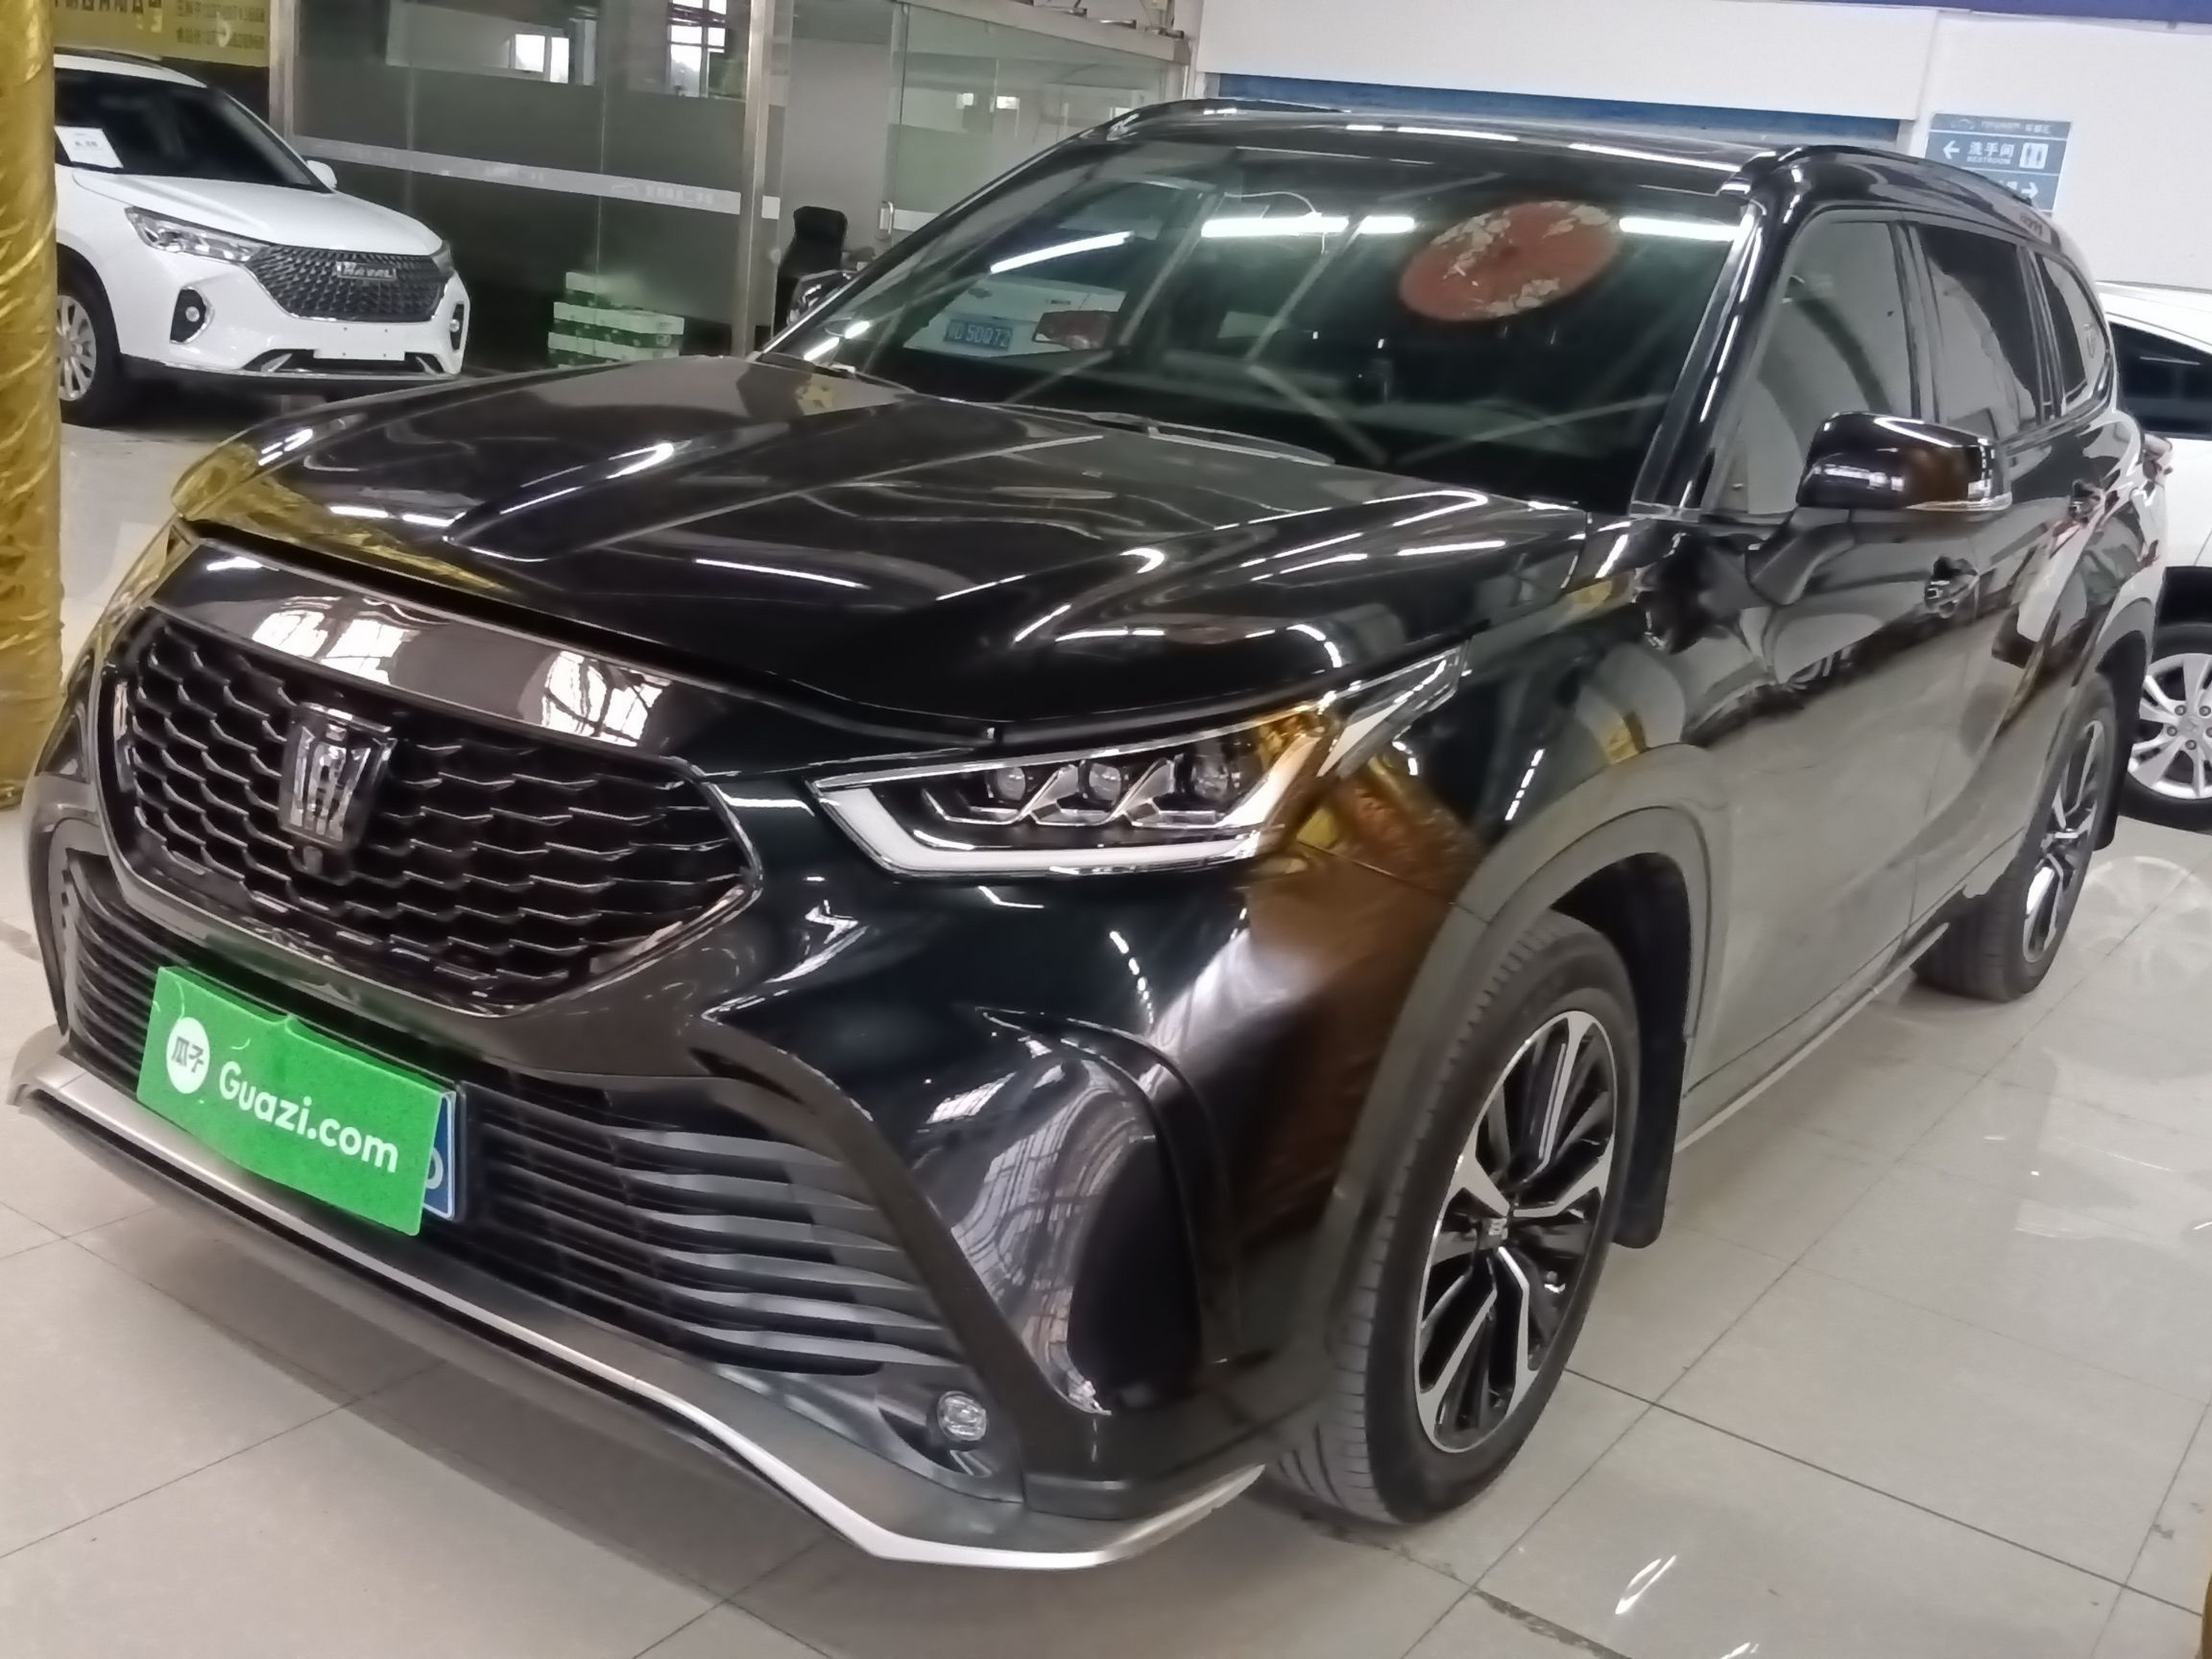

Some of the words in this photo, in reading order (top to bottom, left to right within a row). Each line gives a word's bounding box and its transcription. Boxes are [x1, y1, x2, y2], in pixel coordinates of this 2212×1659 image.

[1968, 141, 2015, 158] 洗手间
[343, 262, 394, 278] HAVAL
[172, 1036, 204, 1073] 瓜子
[219, 1060, 399, 1173] Guazi.com
